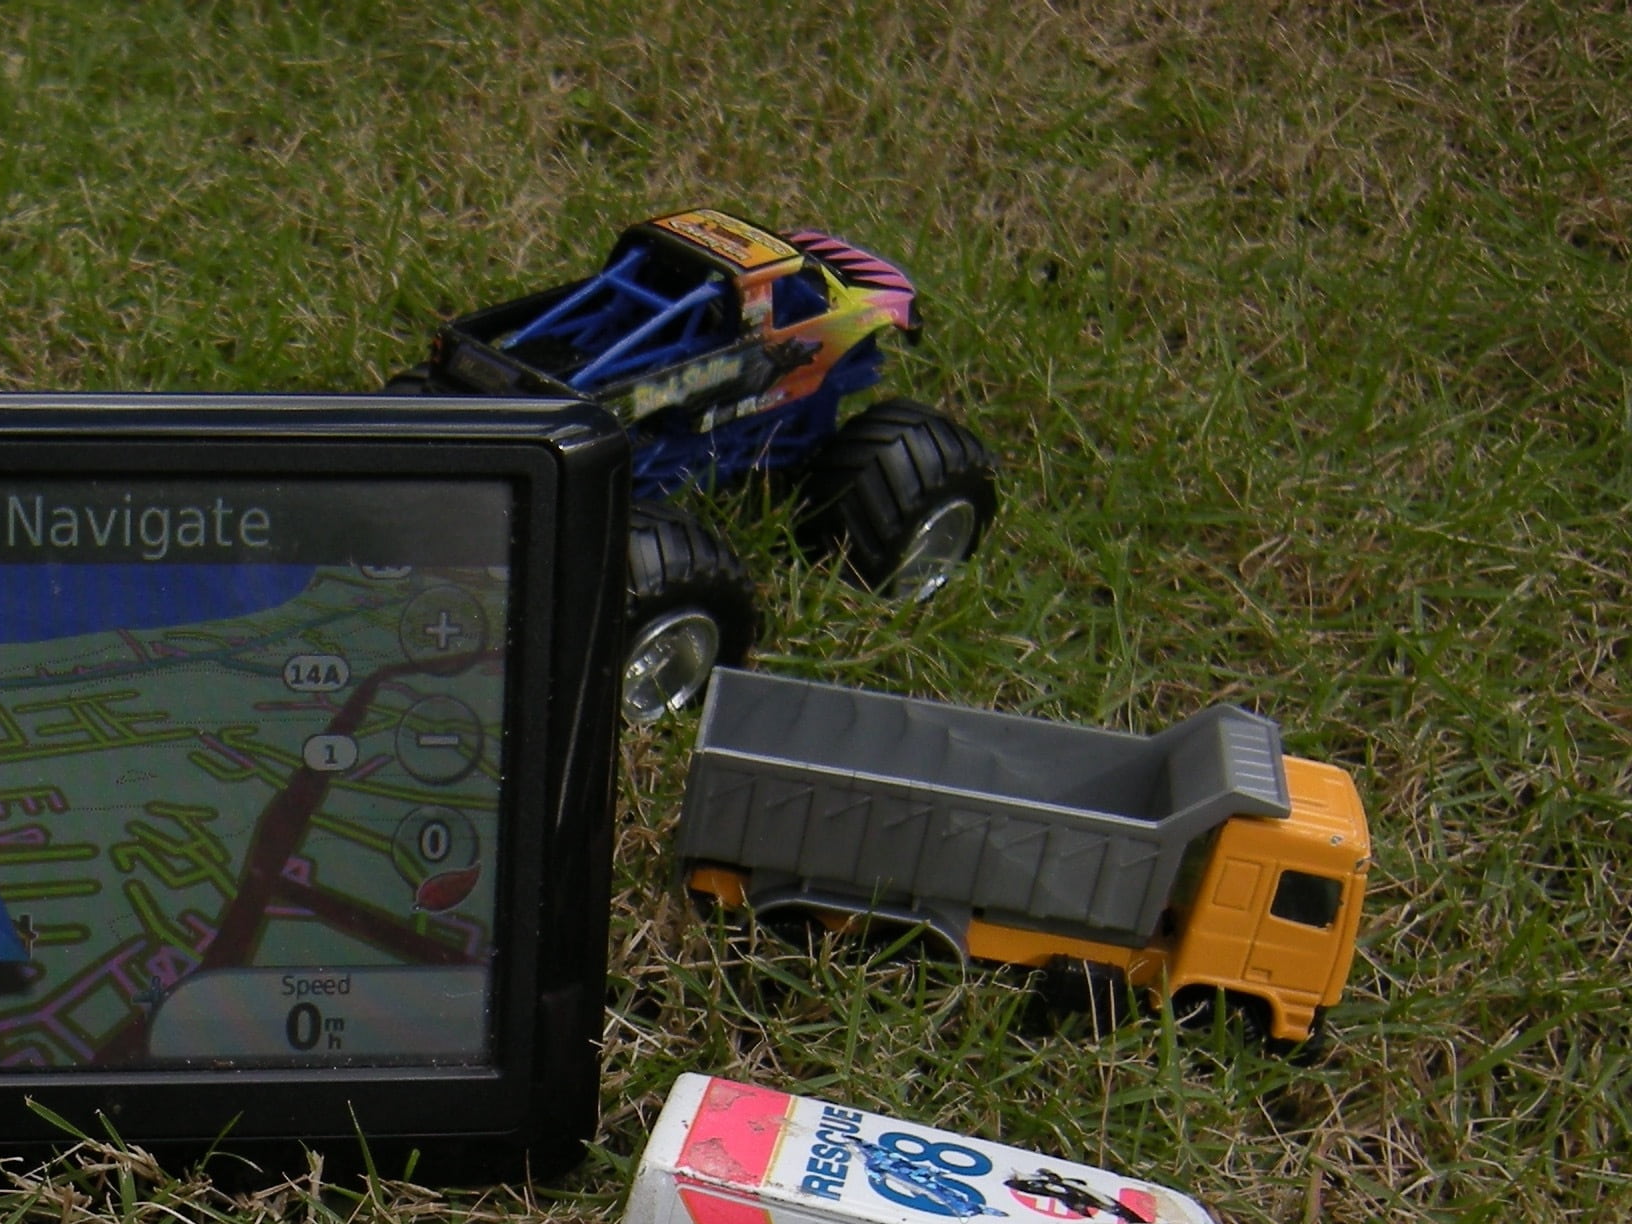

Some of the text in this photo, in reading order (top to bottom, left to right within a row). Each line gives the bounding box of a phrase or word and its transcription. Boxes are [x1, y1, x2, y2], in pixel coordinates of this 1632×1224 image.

[7, 494, 271, 561] Navigate
[289, 662, 341, 686] 14A
[324, 743, 337, 764] 1
[421, 821, 451, 862] 0
[281, 974, 351, 999] Speed
[285, 1002, 322, 1051] 0
[800, 1105, 864, 1202] RESCUE
